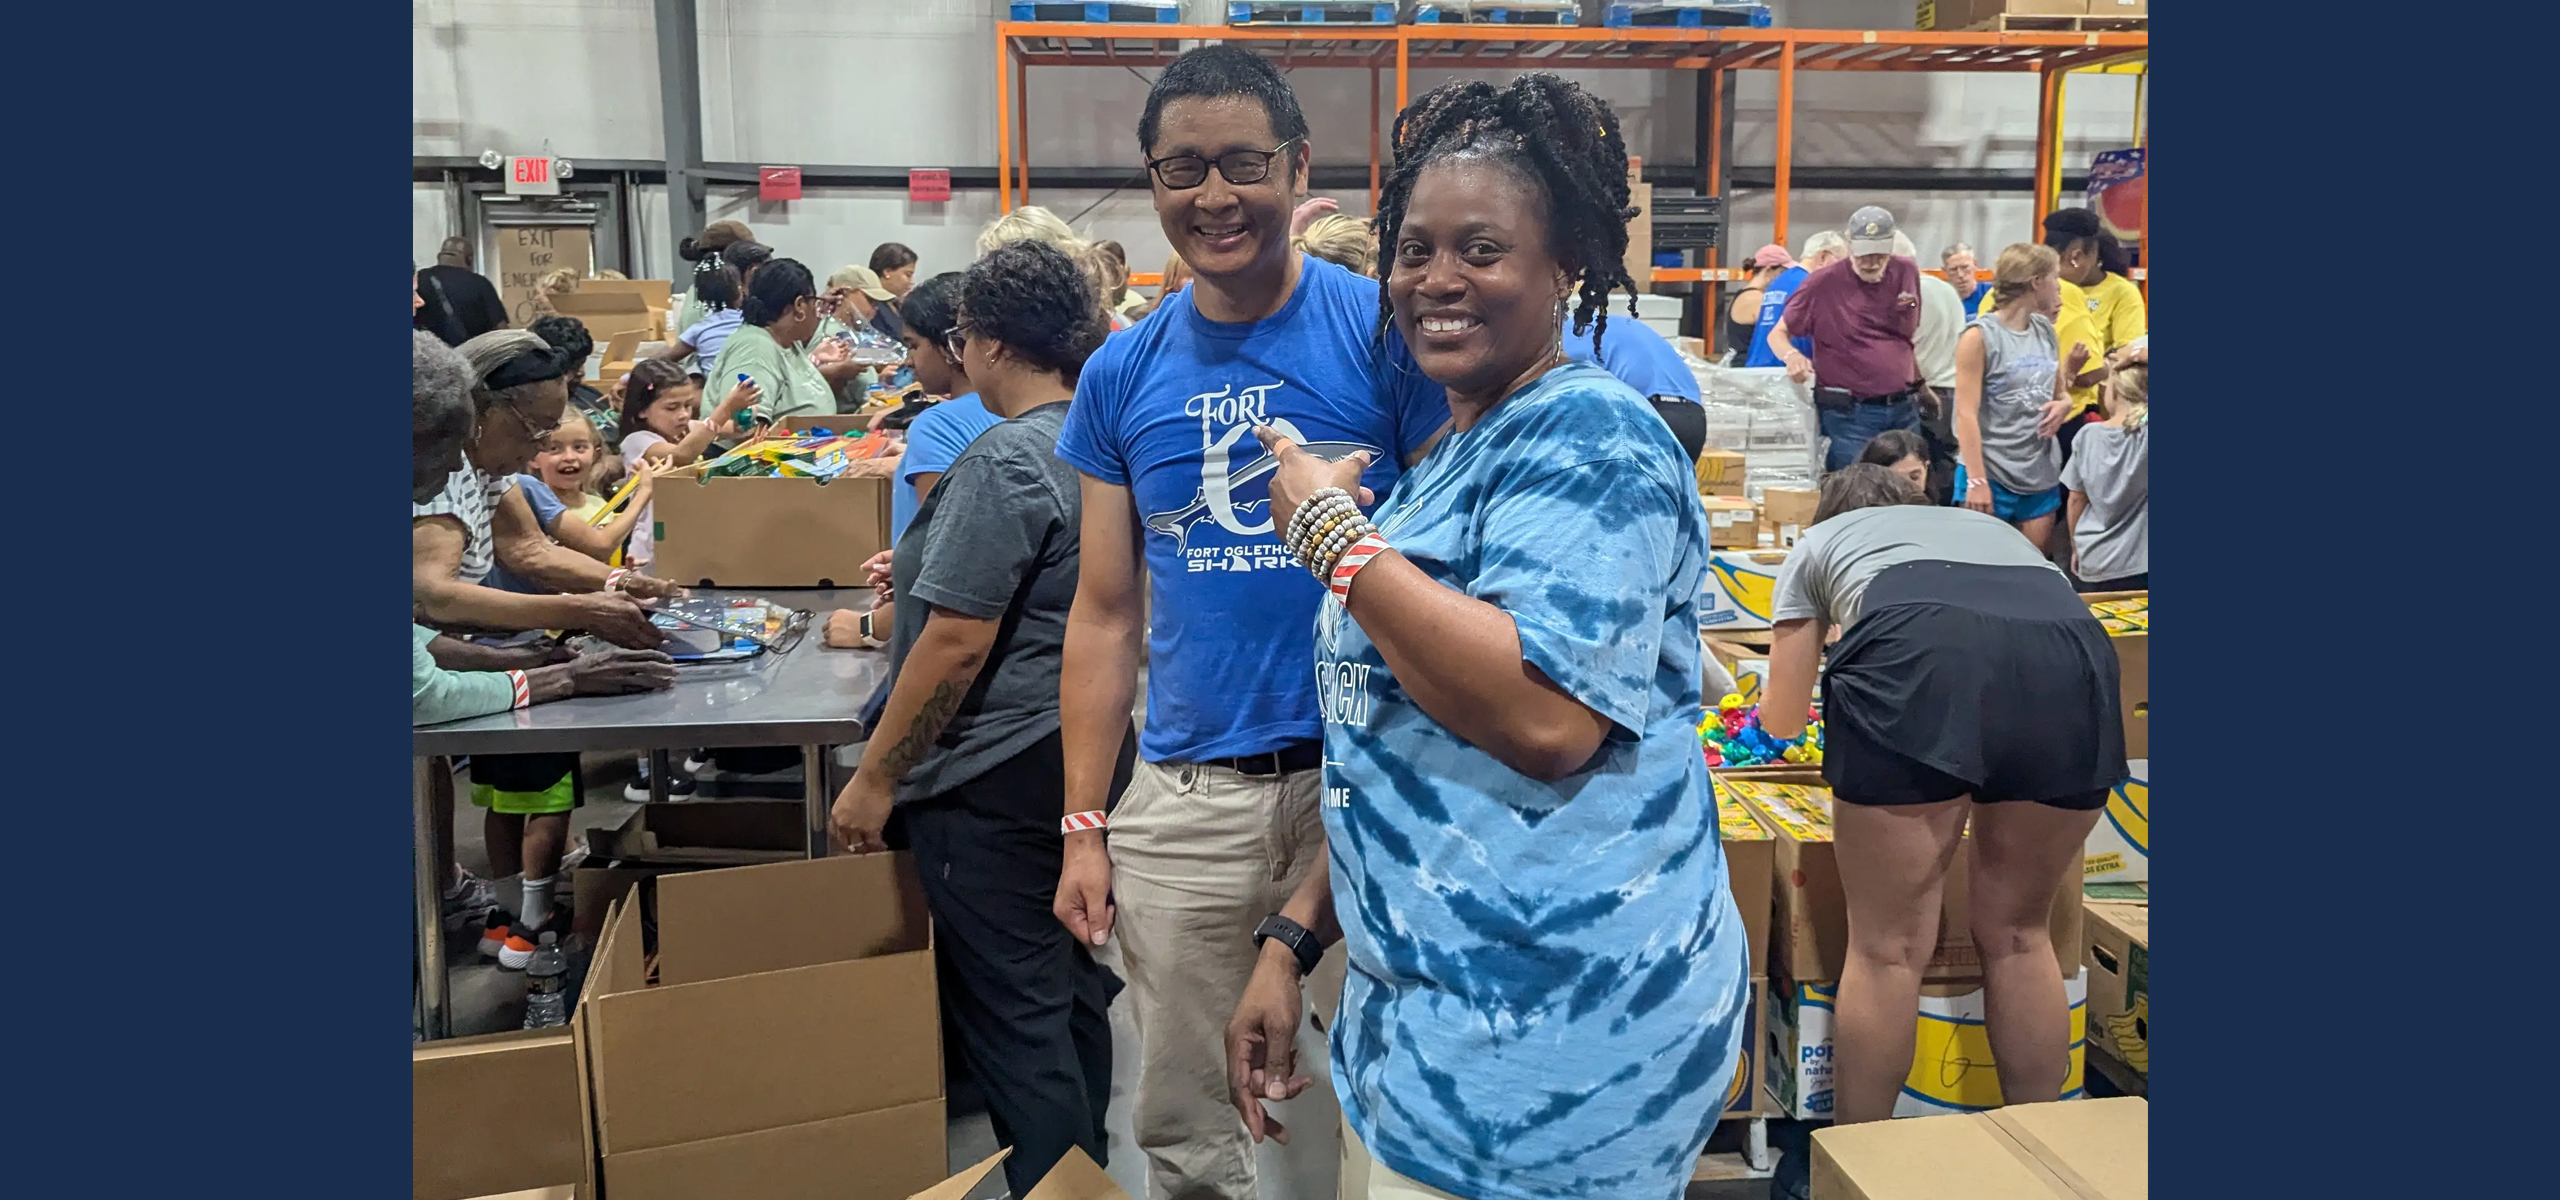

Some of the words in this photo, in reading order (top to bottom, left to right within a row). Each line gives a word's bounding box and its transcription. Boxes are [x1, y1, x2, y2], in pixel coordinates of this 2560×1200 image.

[514, 158, 549, 183] EXIT
[518, 228, 558, 249] EXIT
[530, 252, 554, 267] FOR
[1185, 380, 1285, 449] FORT
[1186, 547, 1220, 559] FORT
